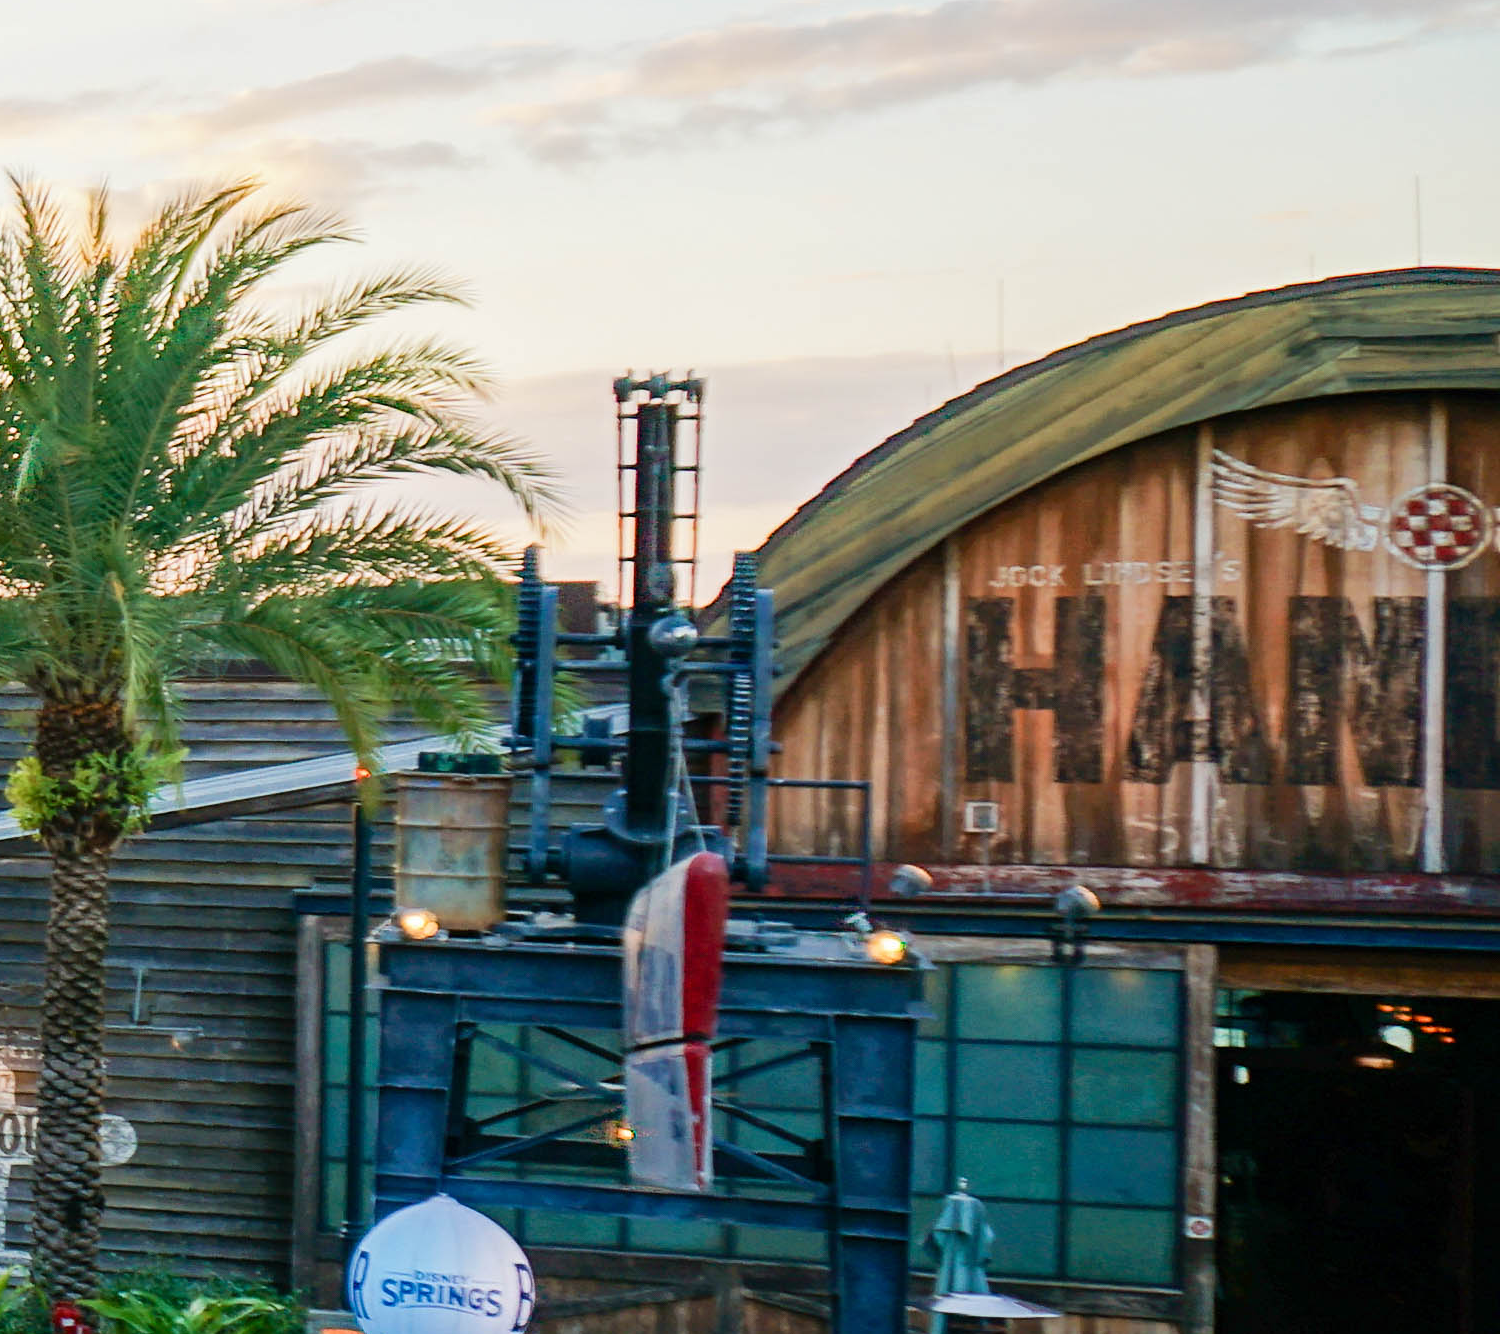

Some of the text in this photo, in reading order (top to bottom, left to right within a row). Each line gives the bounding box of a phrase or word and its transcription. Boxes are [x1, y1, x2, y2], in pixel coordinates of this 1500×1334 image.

[988, 551, 1242, 587] JOCK LINDSE'S
[414, 1270, 470, 1284] DISNEY
[381, 1278, 503, 1318] SPRINGS
